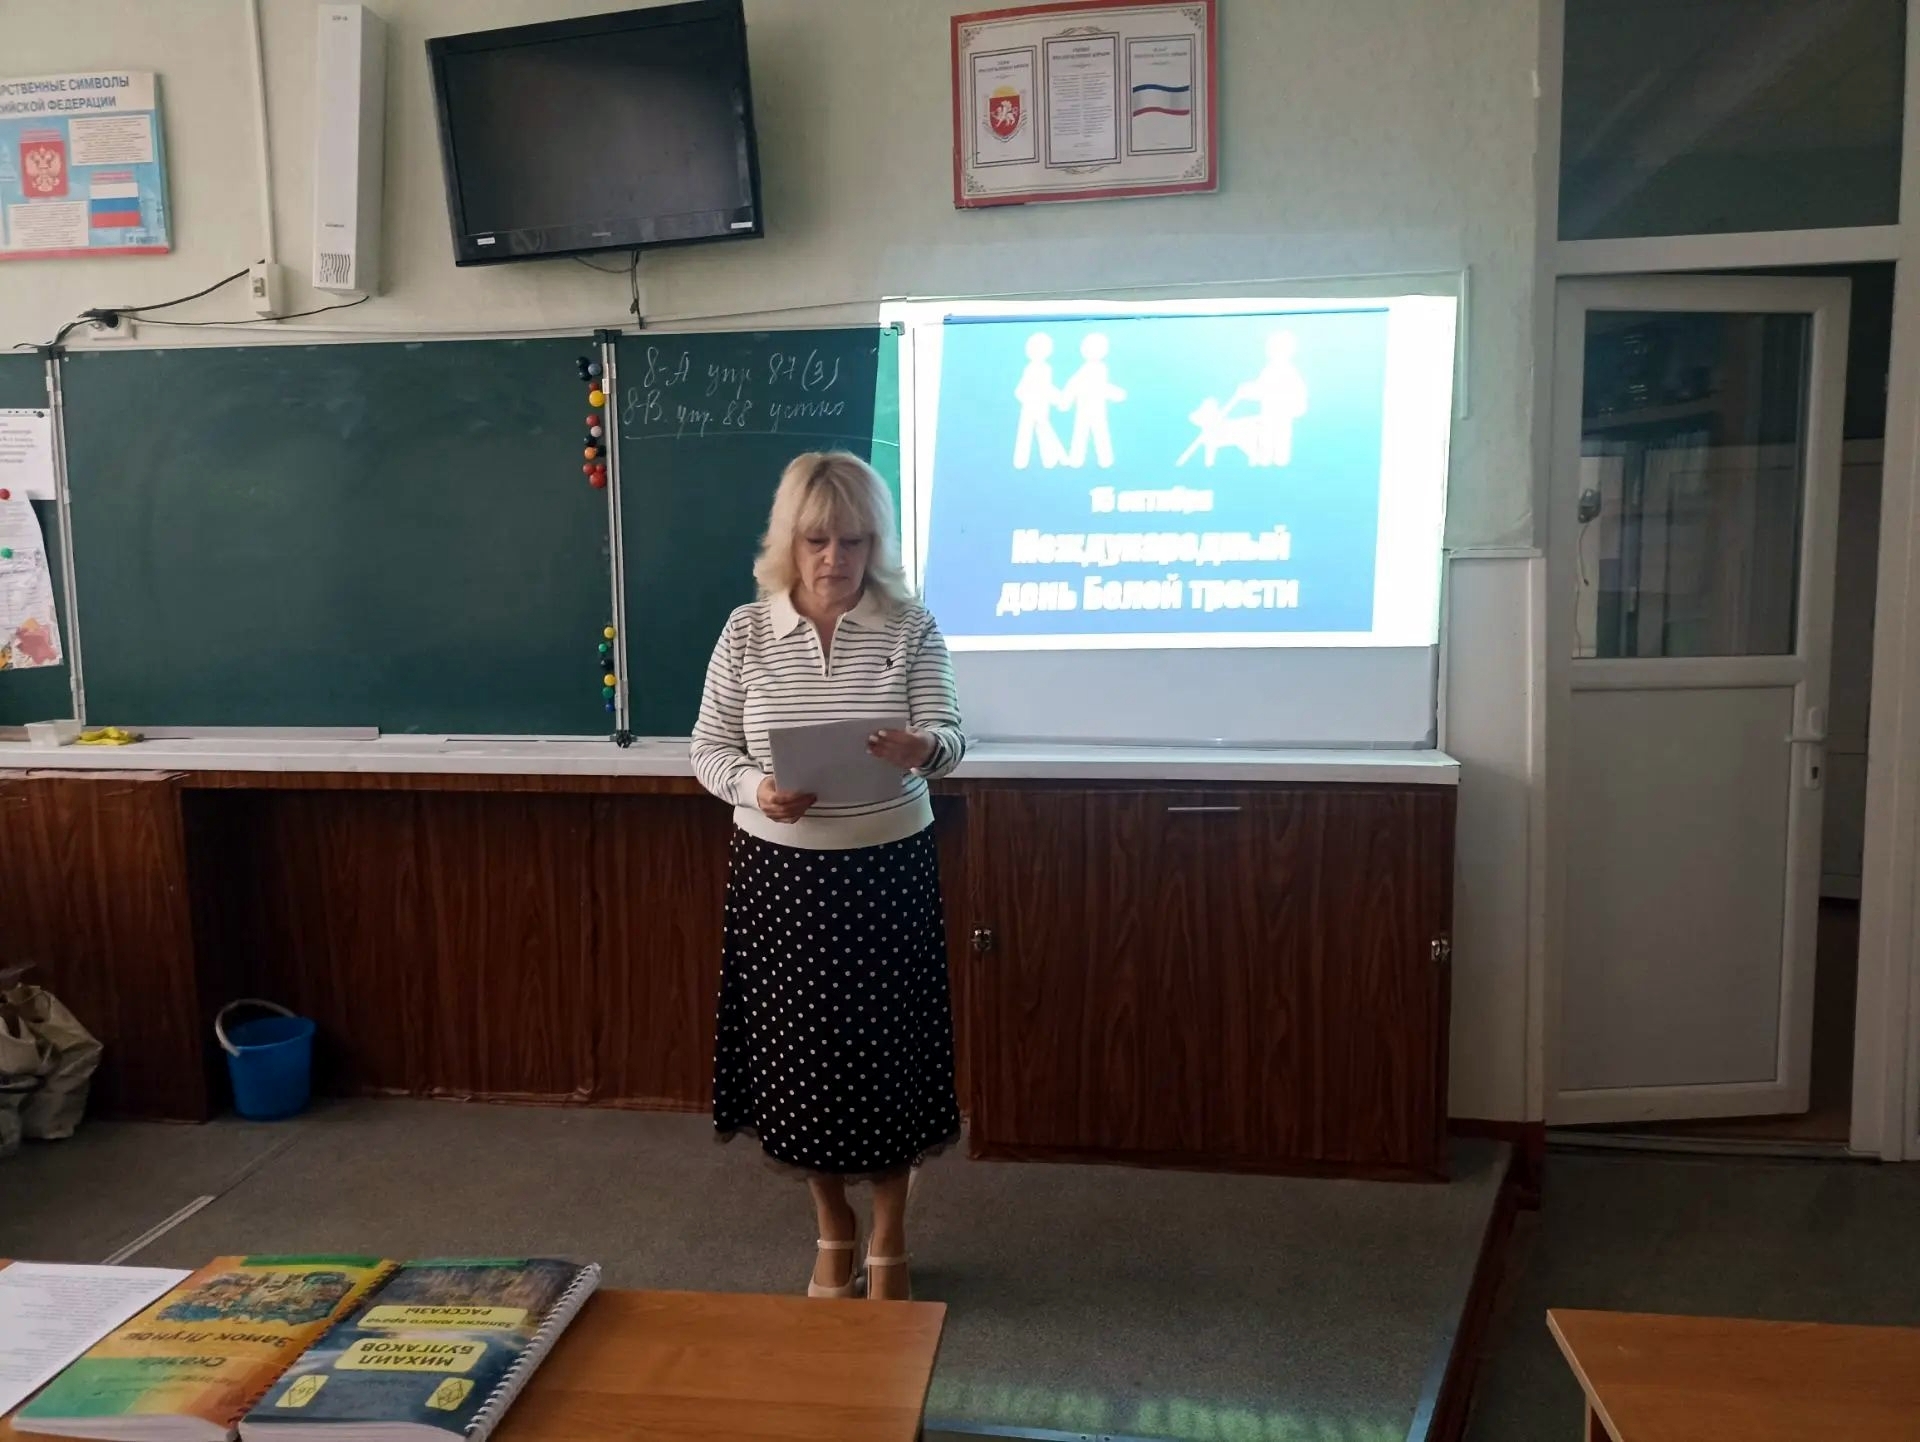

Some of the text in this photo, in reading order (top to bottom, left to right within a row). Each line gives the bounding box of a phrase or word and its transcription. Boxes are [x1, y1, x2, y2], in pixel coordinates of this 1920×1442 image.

[69, 75, 129, 91] СИМВОЛЫ
[47, 95, 117, 111] ФЕДЕРАЦИИ
[722, 399, 753, 428] 88
[1011, 525, 1290, 567] Международный
[1188, 578, 1299, 612] трости
[404, 1307, 493, 1317] РАССКАЗЫ
[456, 1318, 515, 1329] Записки
[360, 1342, 474, 1355] БУЛГАКОВ
[358, 1354, 454, 1367] МИХАИЛ
